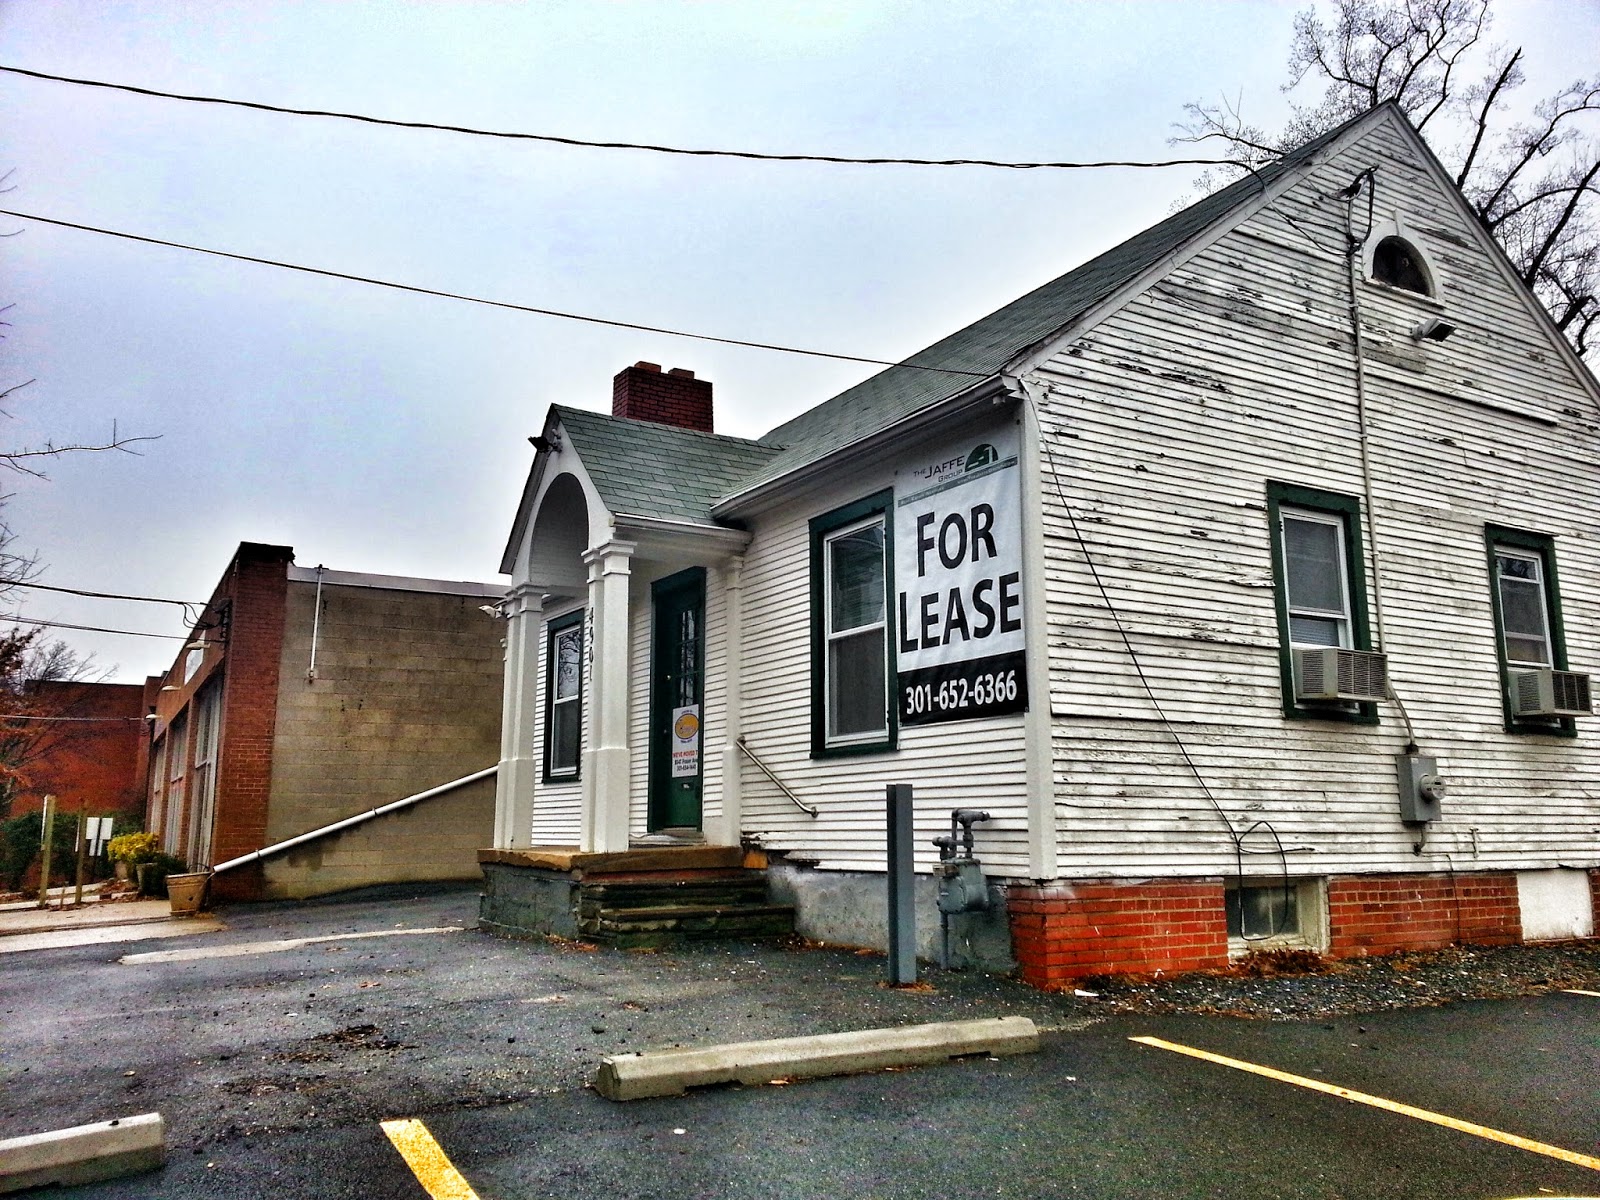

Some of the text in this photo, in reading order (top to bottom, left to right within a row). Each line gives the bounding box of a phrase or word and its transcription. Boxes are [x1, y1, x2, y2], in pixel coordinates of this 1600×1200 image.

[913, 455, 965, 479] THE JAFFE
[938, 469, 963, 482] GROUP
[917, 503, 997, 577] FOR
[900, 571, 1021, 654] LEASE
[906, 670, 1017, 715] 301-652-6366
